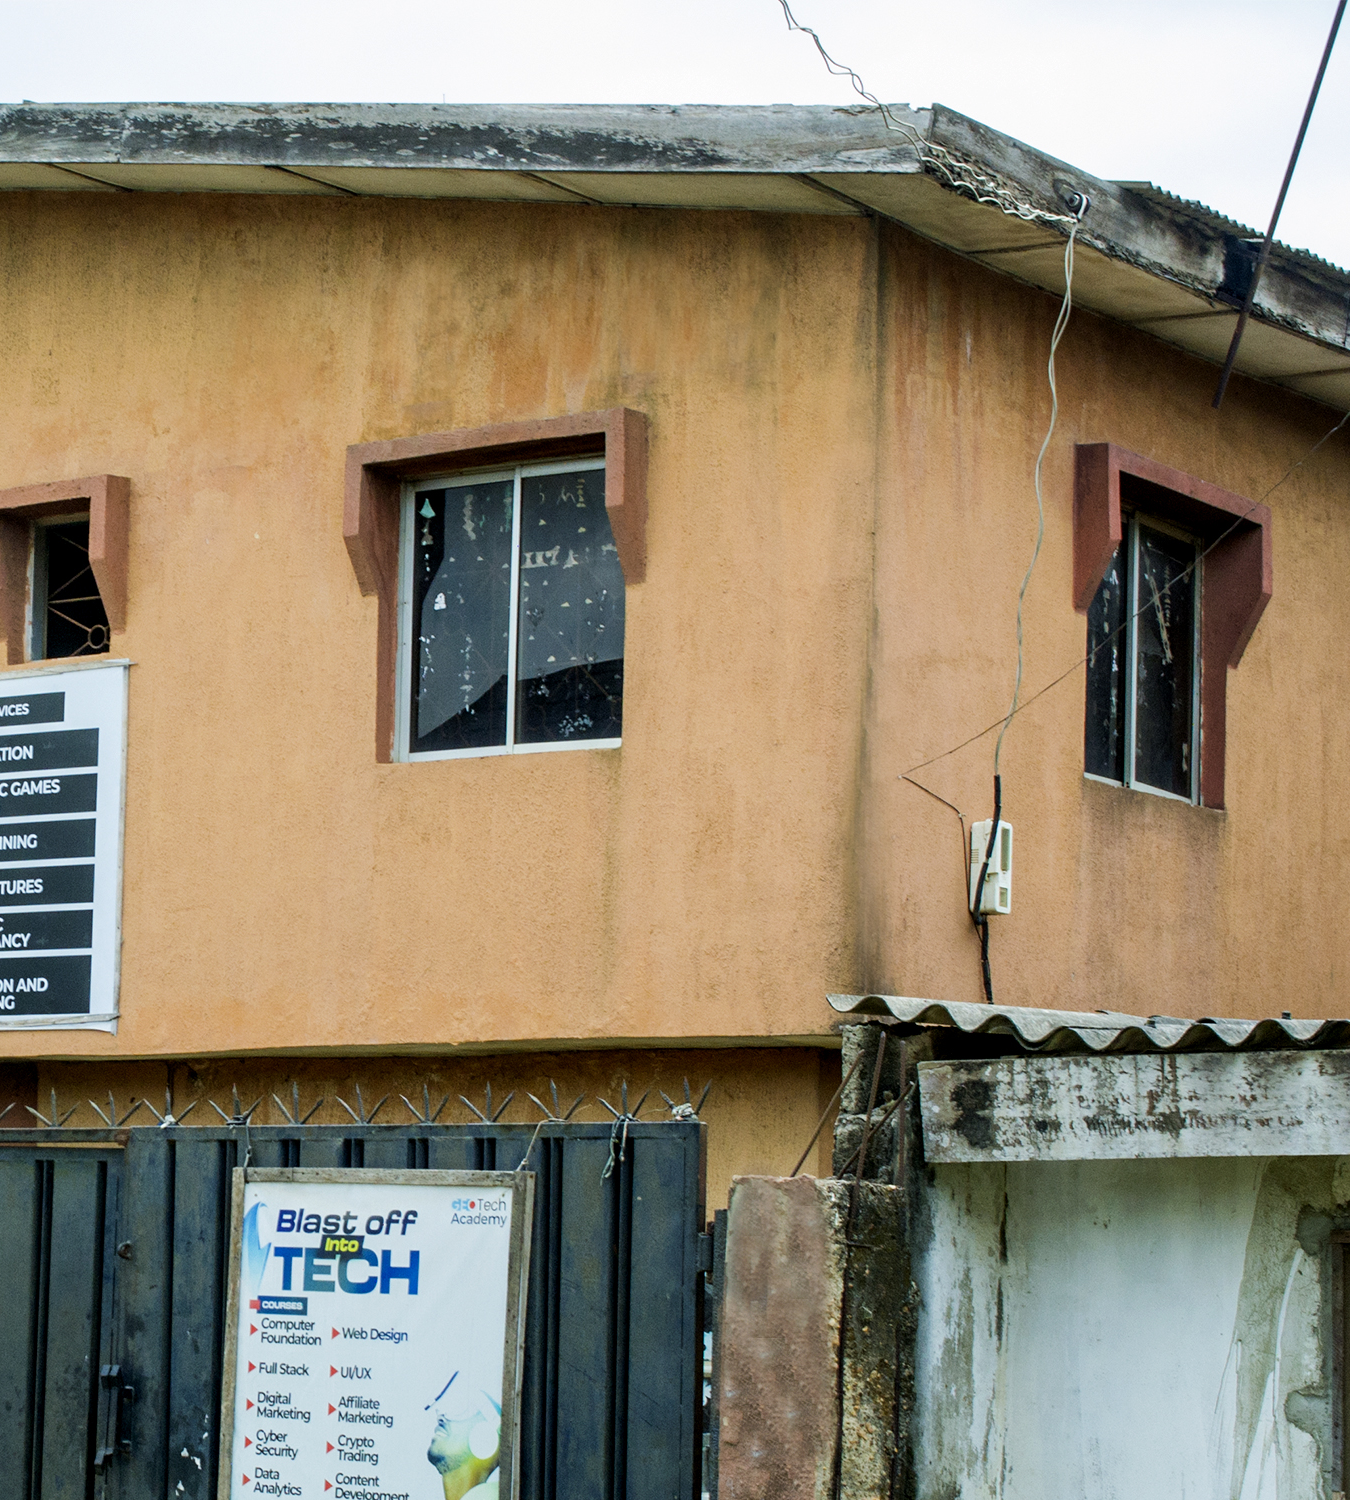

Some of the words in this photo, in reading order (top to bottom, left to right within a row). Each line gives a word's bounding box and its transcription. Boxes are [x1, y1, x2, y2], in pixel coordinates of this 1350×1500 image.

[10, 779, 61, 796] GAMES
[16, 977, 49, 992] AND
[477, 1198, 507, 1212] Tech
[276, 1208, 358, 1235] Blast
[365, 1209, 418, 1236] off
[450, 1212, 507, 1228] Academy
[324, 1237, 359, 1253] Into
[274, 1246, 420, 1295] TECH
[261, 1301, 304, 1310] COURSES
[261, 1317, 315, 1332] Computer
[260, 1332, 322, 1346] Foundation
[342, 1327, 368, 1340] Web
[370, 1328, 408, 1344] Design
[259, 1362, 277, 1375] Full
[279, 1363, 310, 1377] Stack
[340, 1365, 372, 1380] UI/UX
[257, 1391, 291, 1407] Digital
[338, 1396, 380, 1410] Affiliate
[256, 1407, 311, 1423] Marketing
[338, 1412, 394, 1428] Marketing
[256, 1429, 288, 1444] Cyber
[337, 1434, 375, 1450] Crypto
[255, 1443, 298, 1461] Security
[337, 1449, 379, 1466] Trading
[254, 1467, 280, 1480] Data
[335, 1472, 380, 1487] Content
[253, 1482, 302, 1498] Analytics
[334, 1486, 409, 1500] Development
